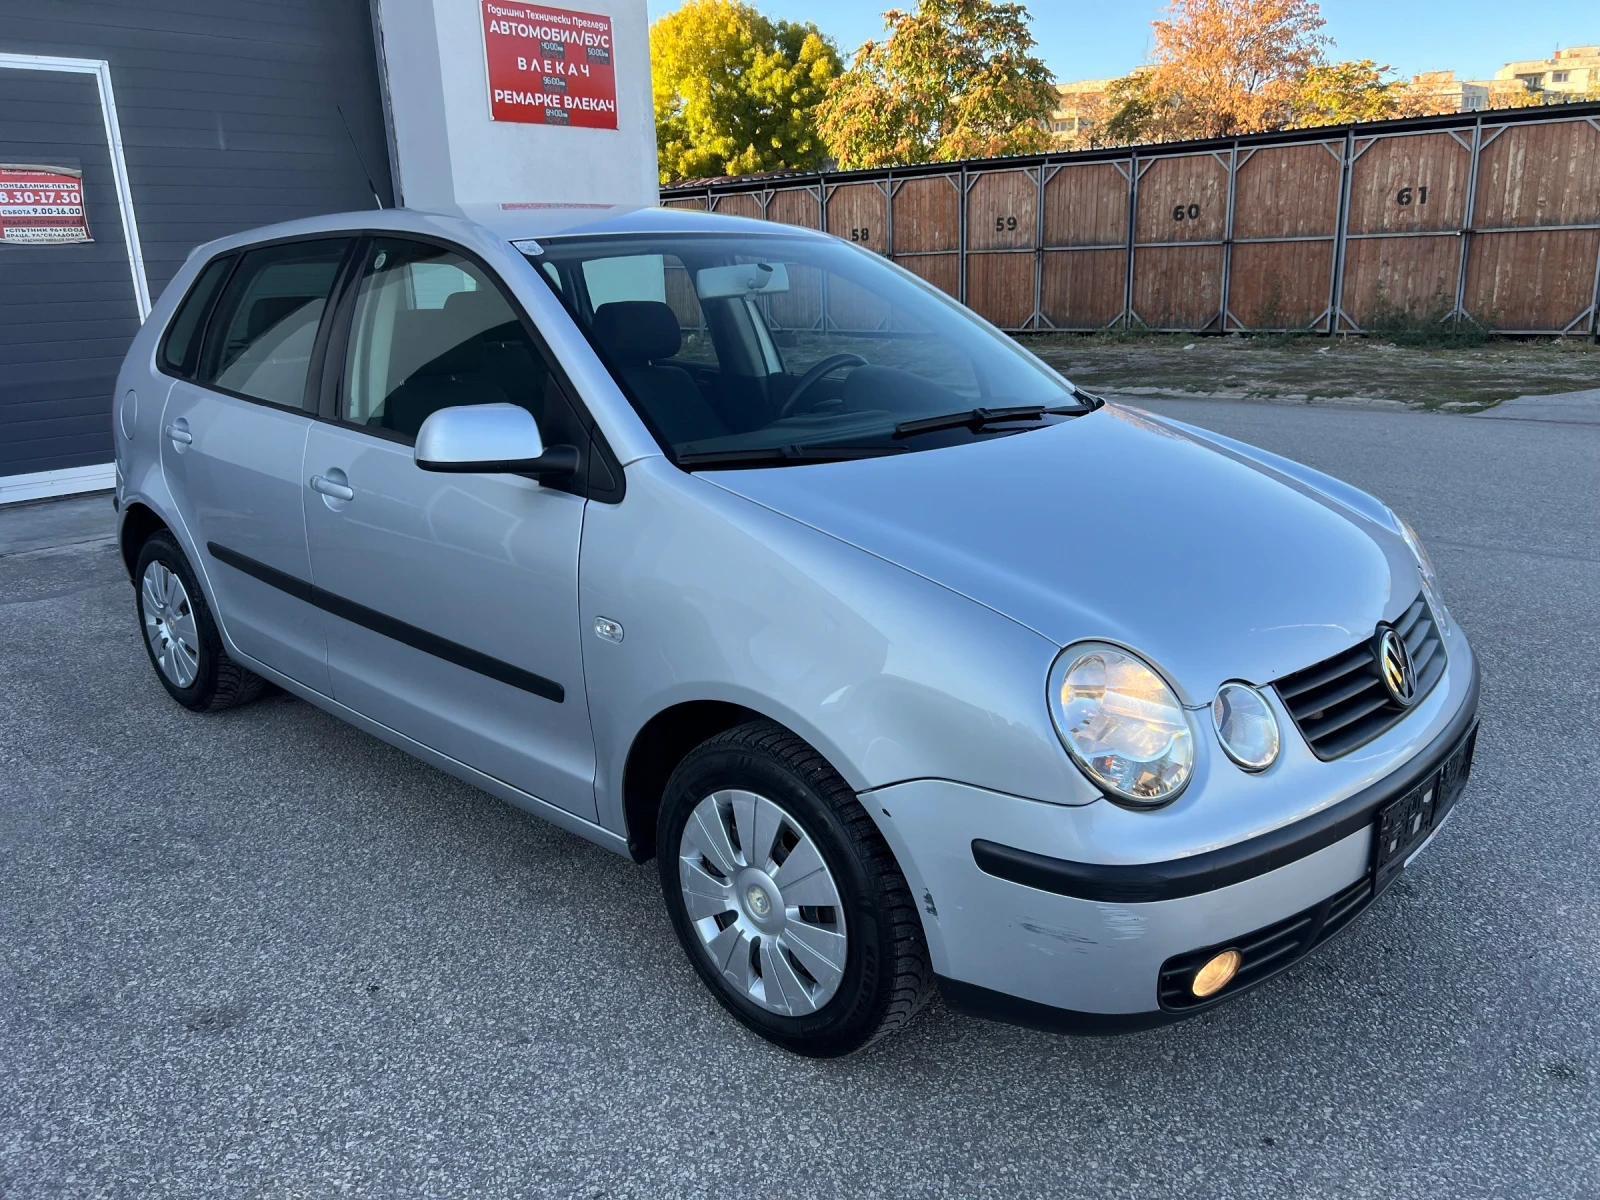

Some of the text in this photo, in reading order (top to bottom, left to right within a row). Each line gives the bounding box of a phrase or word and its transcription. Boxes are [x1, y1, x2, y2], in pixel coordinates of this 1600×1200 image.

[487, 4, 608, 31] Годишни Технически Прегледи
[489, 19, 610, 48] АВТОМОБИЛ/БУС
[517, 56, 590, 77] ВЛЕКАЧ
[494, 89, 561, 108] РЕМАРКЕ
[563, 96, 615, 112] ВЛЕКАЧ
[1396, 186, 1428, 206] 61
[32, 207, 81, 215] 9.00-16.00
[1172, 203, 1200, 222] 60
[995, 216, 1018, 232] 59
[851, 227, 870, 242] 58
